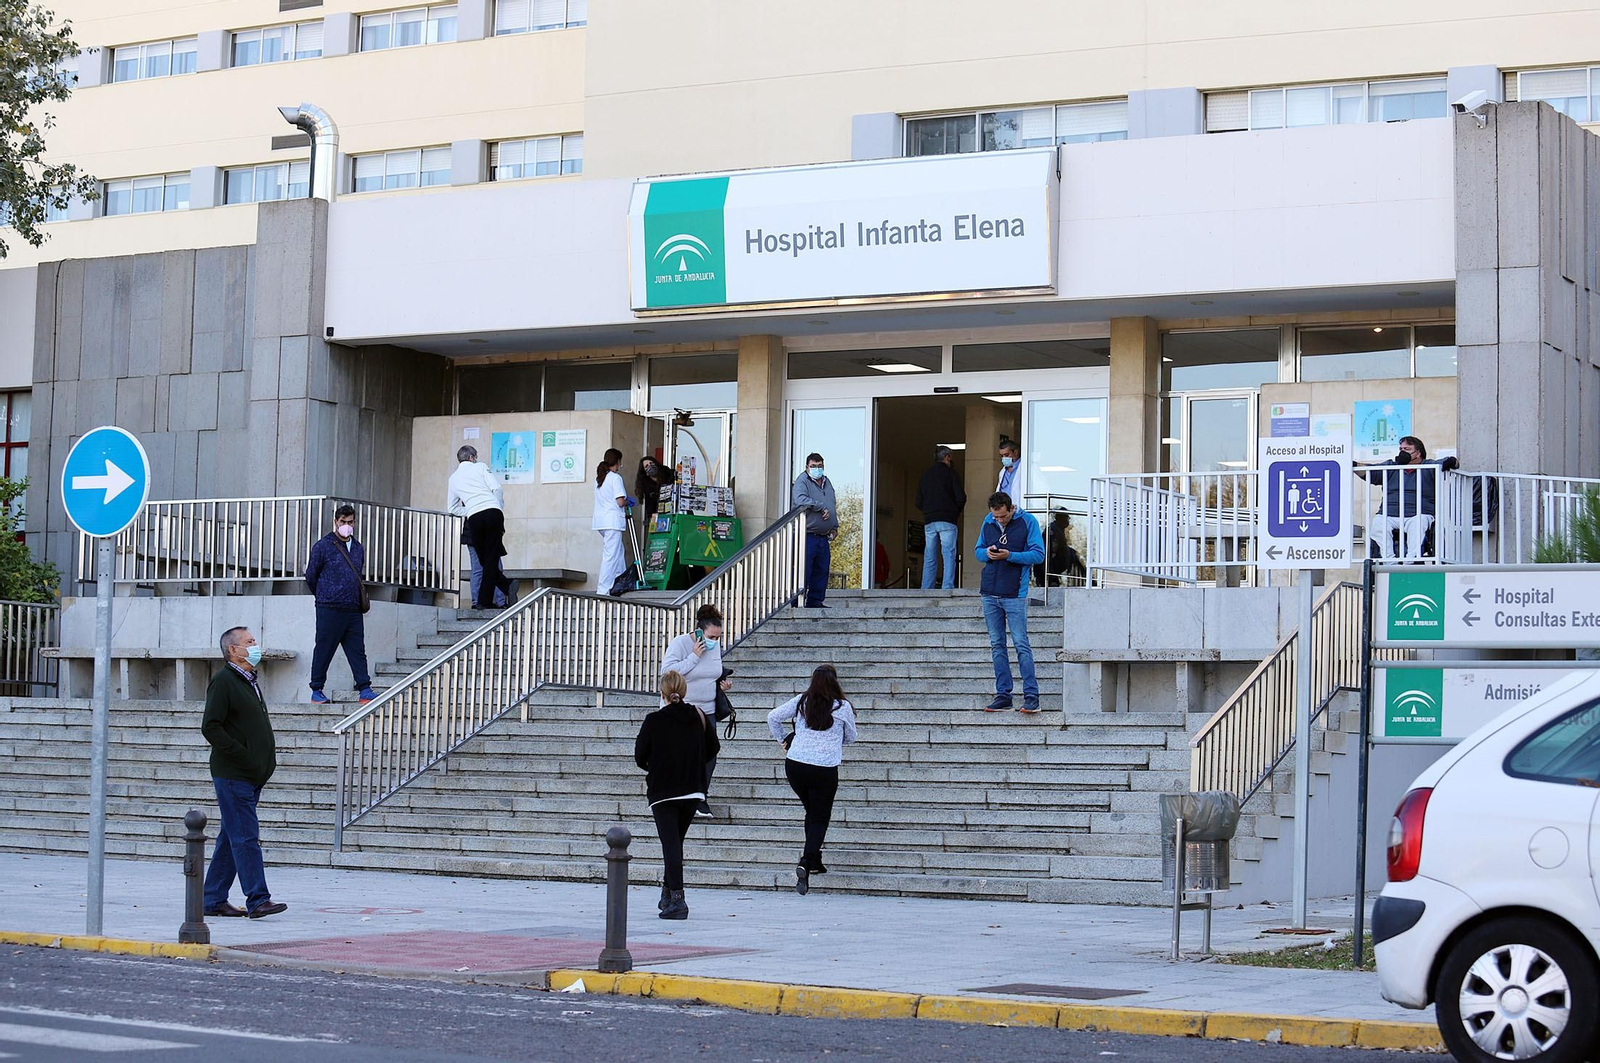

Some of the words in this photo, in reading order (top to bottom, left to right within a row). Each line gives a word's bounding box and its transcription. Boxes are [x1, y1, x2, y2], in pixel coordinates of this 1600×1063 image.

[744, 223, 845, 258] Hospital
[857, 218, 942, 247] Infanta
[954, 213, 1025, 241] Elena
[654, 275, 673, 284] JUNTA
[674, 274, 682, 283] DE
[1265, 446, 1297, 456] Acceso
[1298, 444, 1307, 455] al
[1309, 444, 1345, 457] Hospital
[1286, 545, 1346, 560] Ascensor
[1494, 587, 1554, 608] Hospital
[1494, 610, 1567, 628] Consultas
[1571, 611, 1600, 627] Exte
